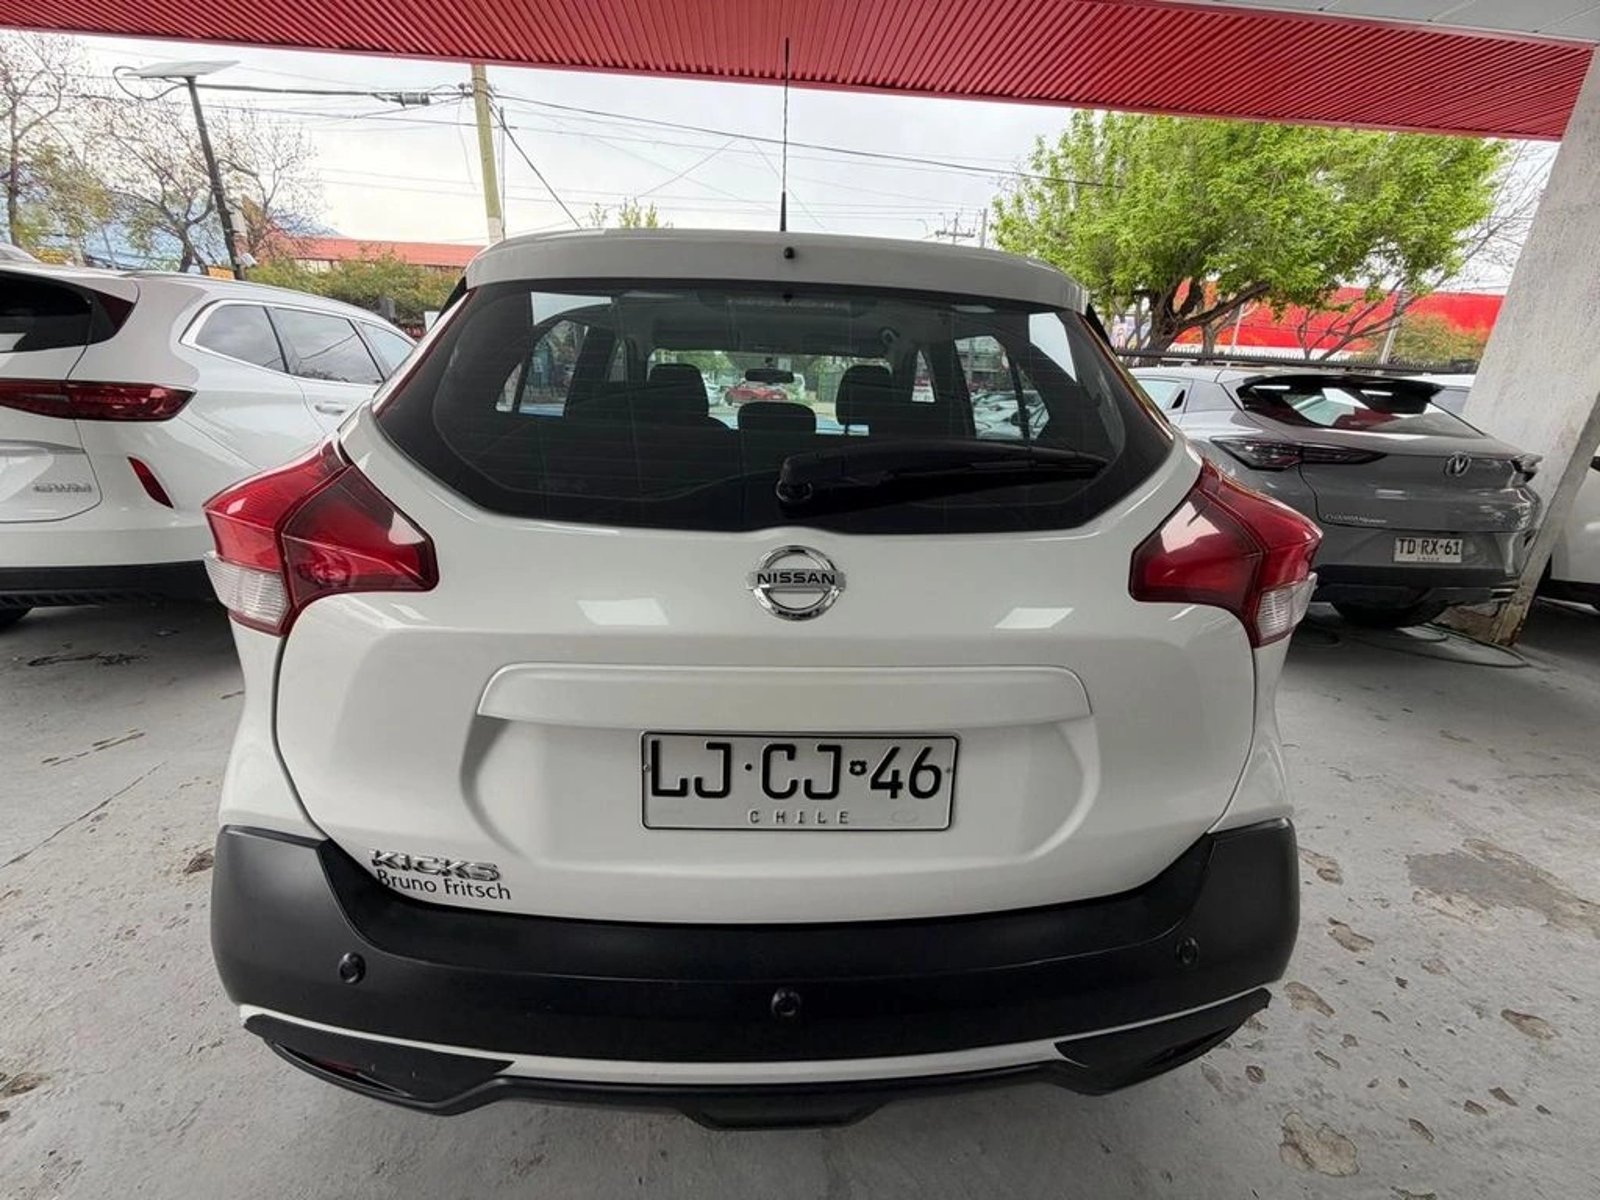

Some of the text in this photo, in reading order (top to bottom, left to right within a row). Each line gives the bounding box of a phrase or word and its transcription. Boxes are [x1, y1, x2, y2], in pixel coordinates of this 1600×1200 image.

[757, 572, 836, 585] NISSAN
[749, 810, 851, 825] CHILE
[370, 848, 501, 882] KICKS
[376, 868, 512, 900] Bruno Fritsch
